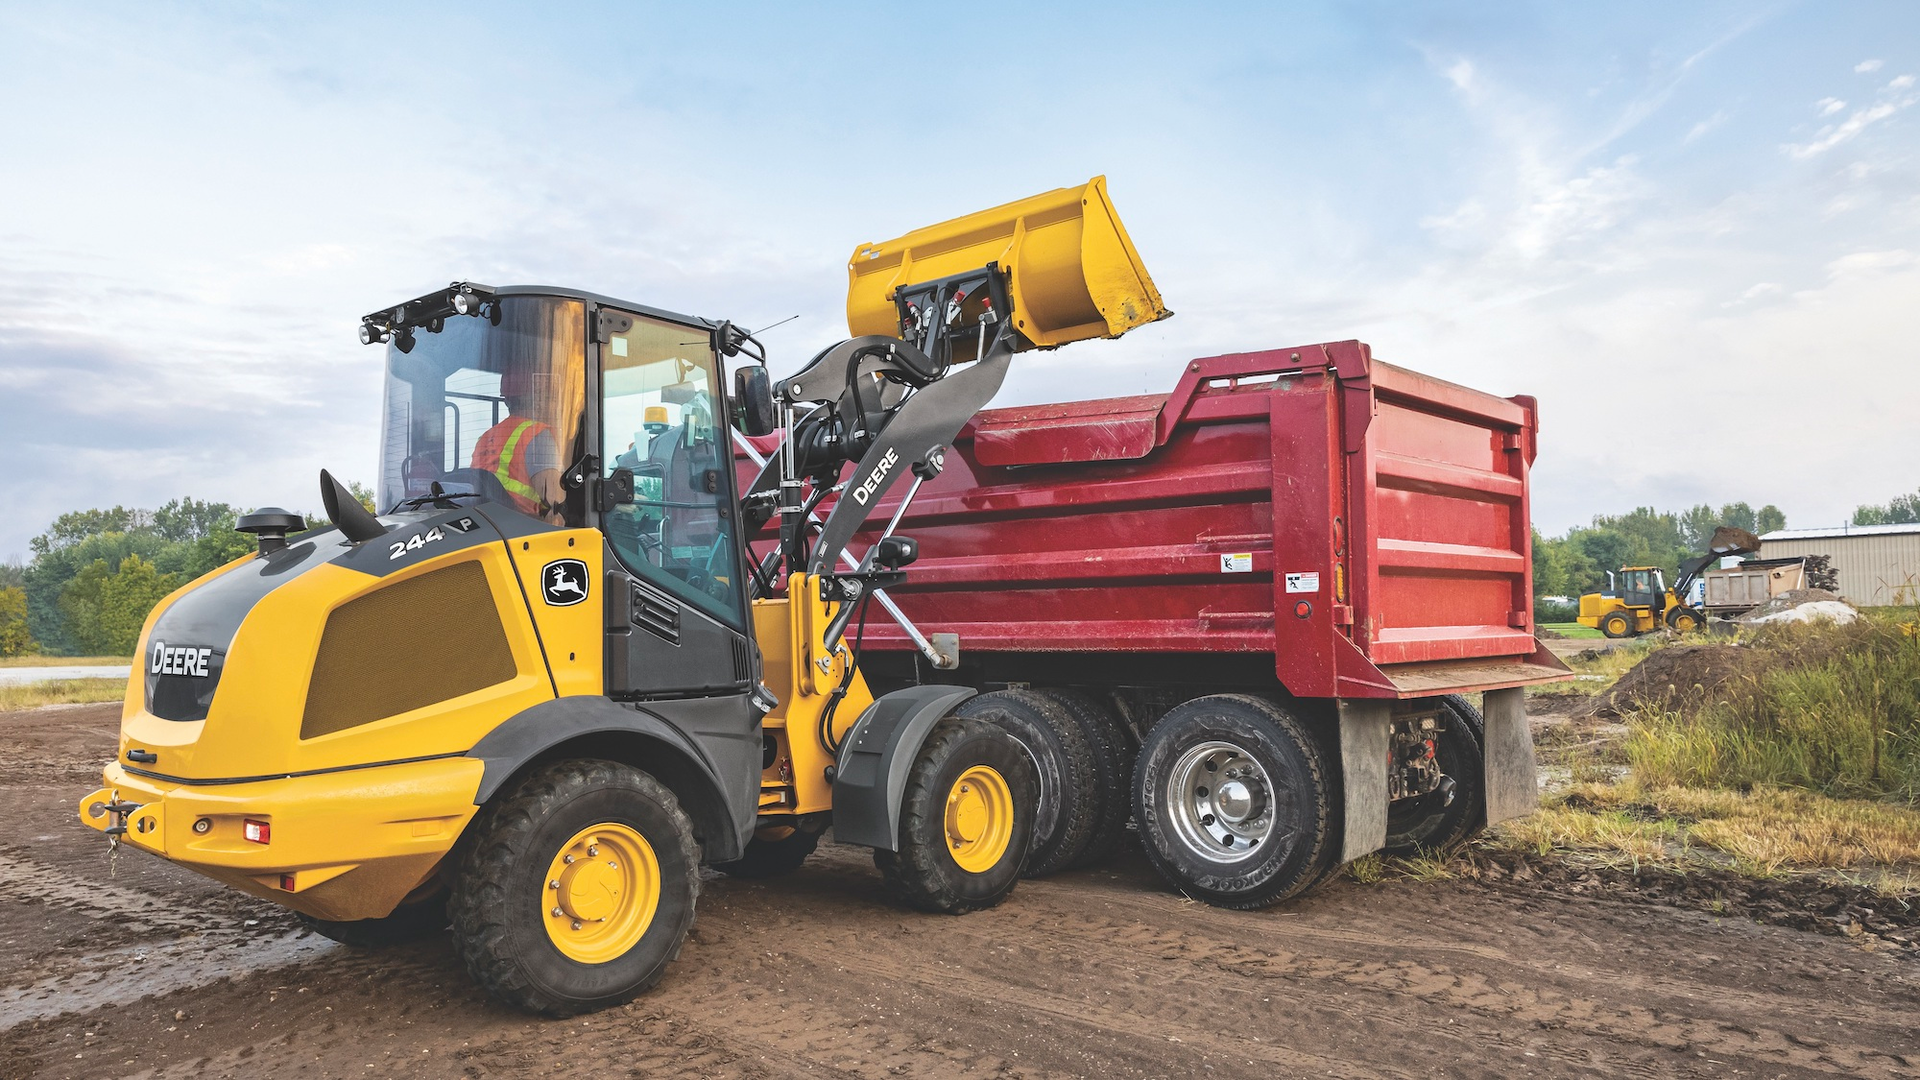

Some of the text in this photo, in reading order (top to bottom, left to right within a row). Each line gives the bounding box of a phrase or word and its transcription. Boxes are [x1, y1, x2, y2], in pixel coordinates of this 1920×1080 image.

[852, 446, 899, 506] DEERE
[389, 518, 472, 560] 244 P
[151, 641, 212, 677] DEERE
